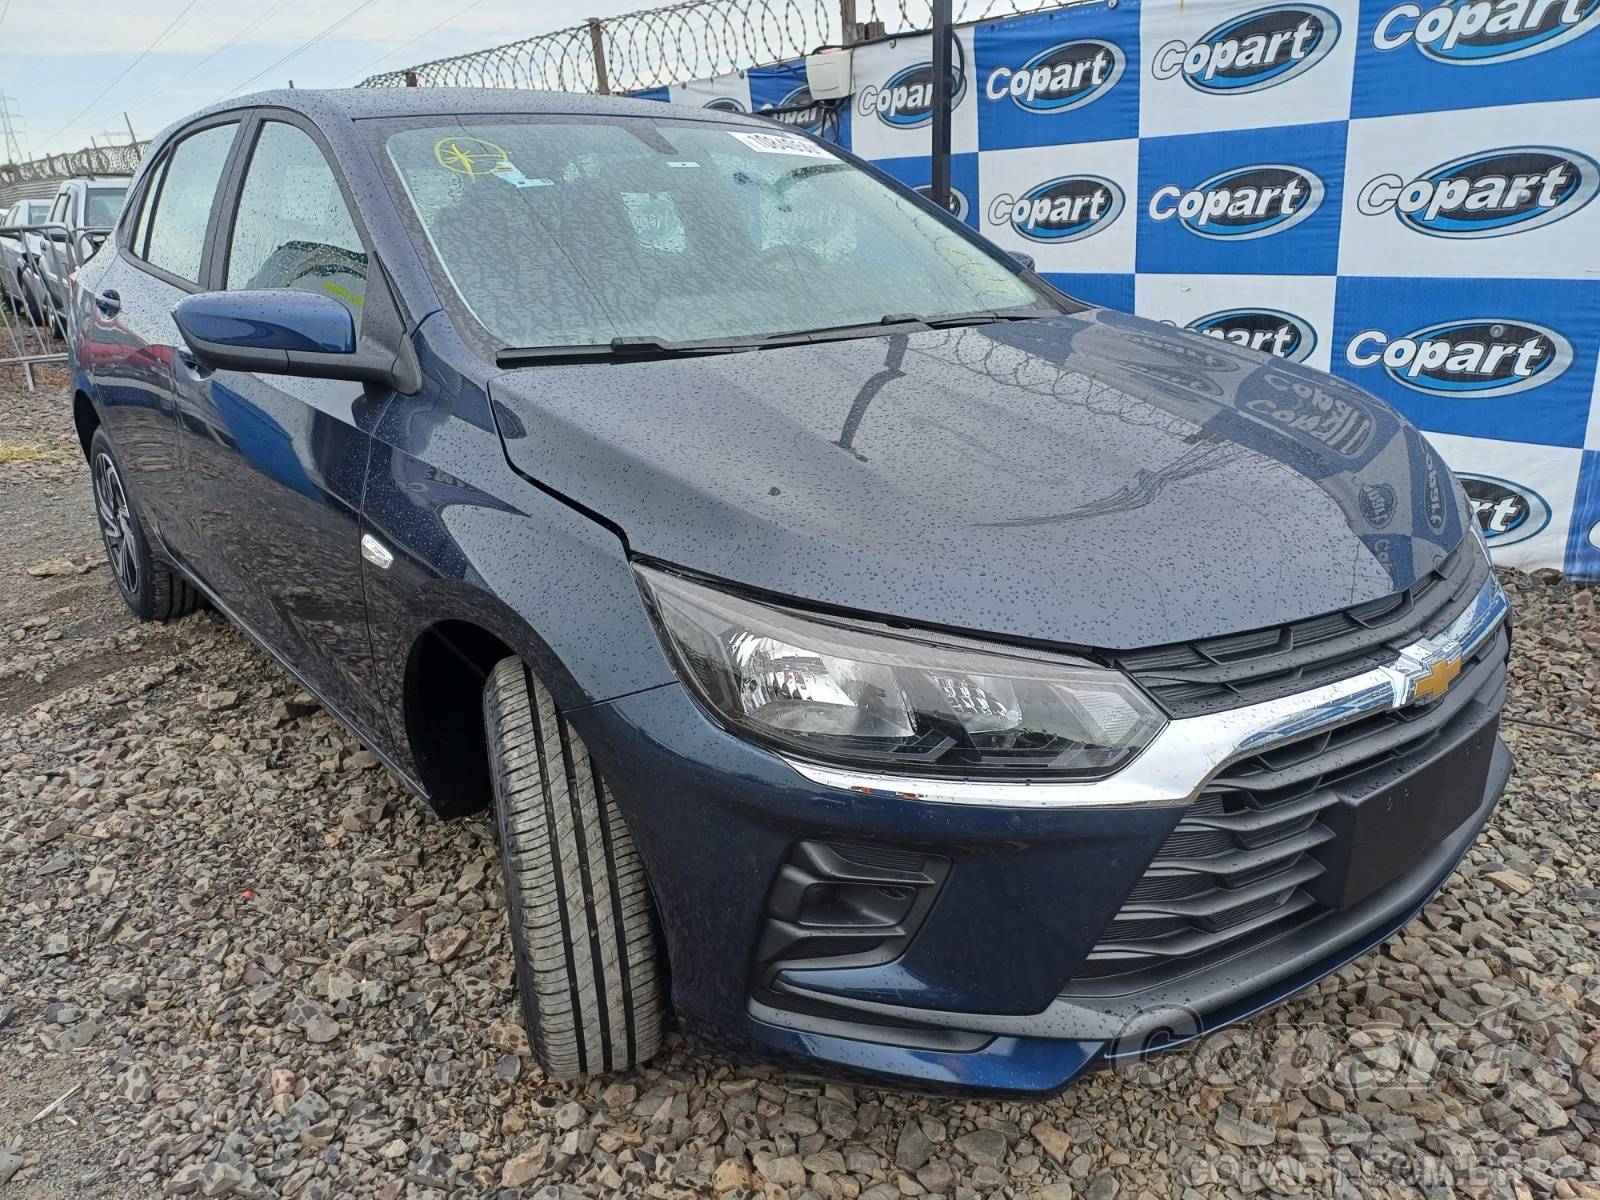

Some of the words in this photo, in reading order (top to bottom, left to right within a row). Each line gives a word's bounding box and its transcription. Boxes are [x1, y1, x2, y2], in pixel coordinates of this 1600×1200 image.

[1152, 15, 1317, 81] Copart
[986, 49, 1110, 102] Copart
[988, 186, 1112, 230] Copart
[1149, 174, 1304, 226] Copart
[1357, 160, 1572, 221] Copart
[1346, 329, 1545, 378] Copart
